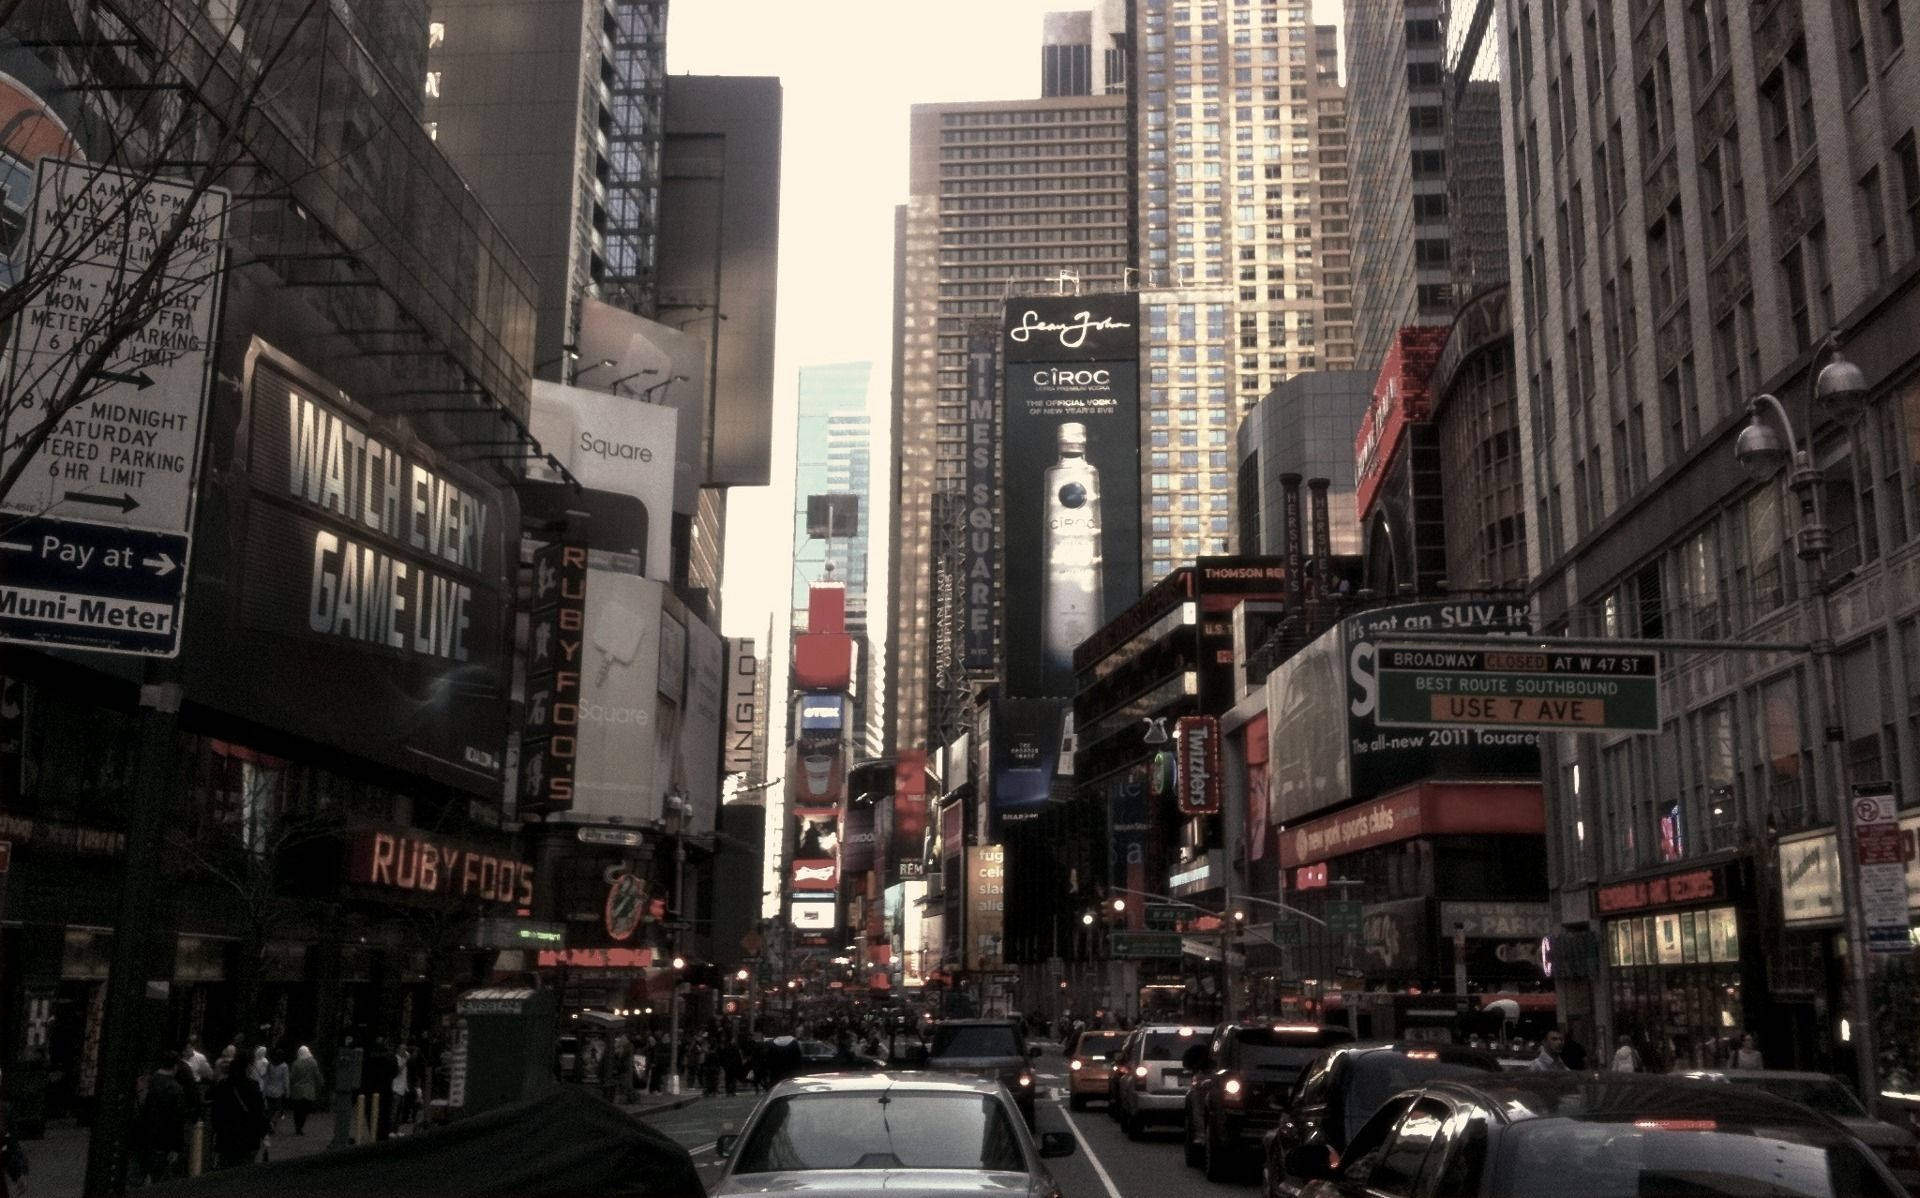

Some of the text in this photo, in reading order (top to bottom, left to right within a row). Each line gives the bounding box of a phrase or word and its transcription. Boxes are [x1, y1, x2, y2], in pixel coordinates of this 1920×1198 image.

[45, 291, 89, 313] MON
[158, 310, 191, 330] FRI
[50, 334, 60, 350] 6
[1011, 310, 1131, 348] Sean John
[1033, 368, 1110, 386] CÎROC
[90, 402, 188, 432] MIDNIGHT
[1045, 399, 1085, 407] OFFICIAL
[1087, 399, 1118, 407] VODKA
[110, 446, 185, 474] PARKING
[580, 431, 653, 464] Square
[49, 460, 146, 488] 6 HR LIMIT
[289, 391, 487, 574] WATCH EVERY
[970, 352, 993, 631] TIMES SQUARE
[41, 535, 134, 570] Pay at
[1205, 567, 1263, 579] THOMSON
[309, 530, 408, 649] GAME
[413, 569, 472, 662] LIVE
[559, 547, 588, 663] RUBY
[1369, 614, 1399, 632] not
[1404, 614, 1432, 630] an
[1440, 605, 1498, 629] SUV.
[1393, 652, 1640, 673] BROADWAY CLOSED AT W 47 ST
[1415, 677, 1619, 696] BEST ROUTE SOUTHBOUND
[734, 640, 758, 764] INGLOT
[1450, 697, 1584, 721] USE 7 AVE
[1371, 732, 1424, 752] all-new
[1429, 728, 1471, 747] 2011
[370, 831, 460, 892] RUBY
